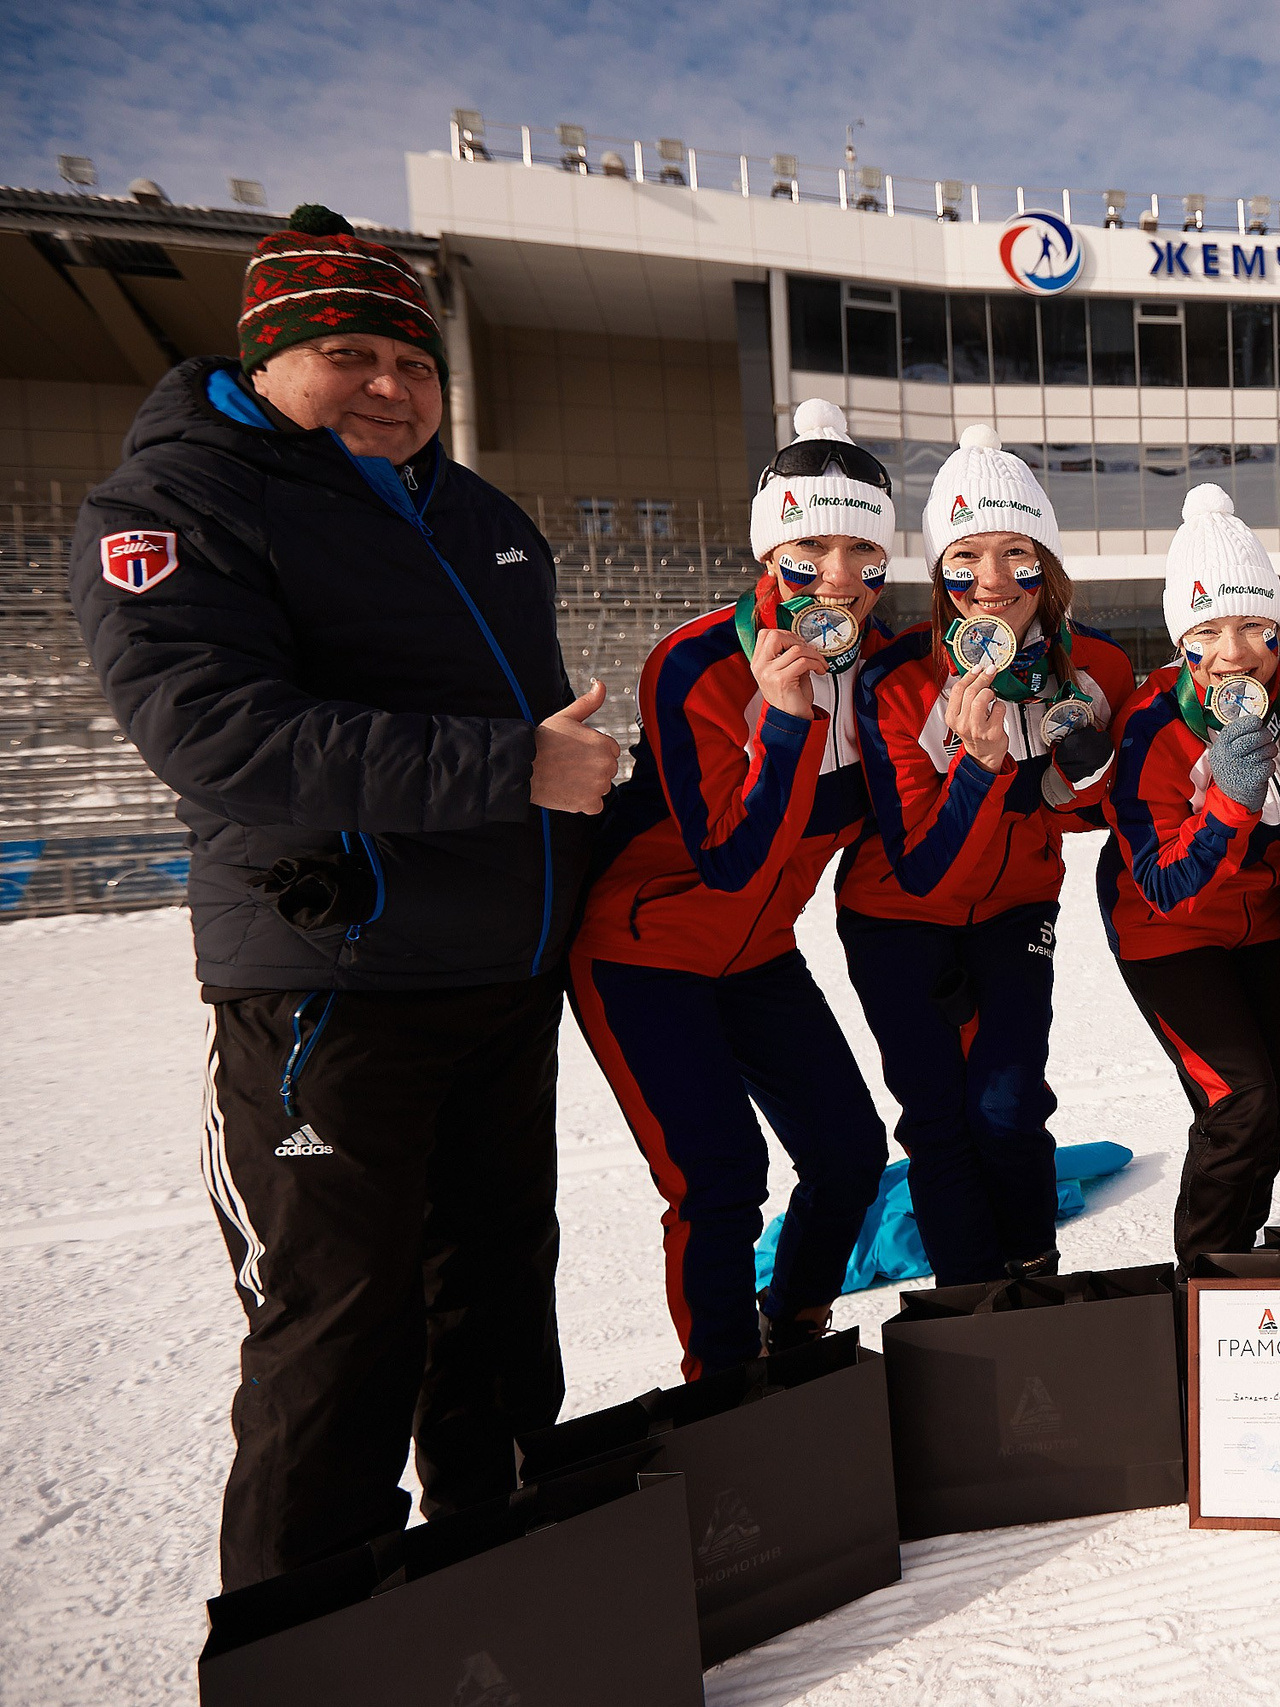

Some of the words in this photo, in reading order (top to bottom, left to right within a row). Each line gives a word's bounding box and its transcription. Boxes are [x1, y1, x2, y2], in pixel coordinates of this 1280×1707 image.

[808, 494, 882, 516] Локомотив
[978, 496, 1042, 518] Локомотив
[862, 568, 879, 579] ЗАП
[956, 571, 972, 579] СИБ
[1218, 584, 1274, 599] Локомотив
[695, 1546, 781, 1590] ОКОМОТИВ
